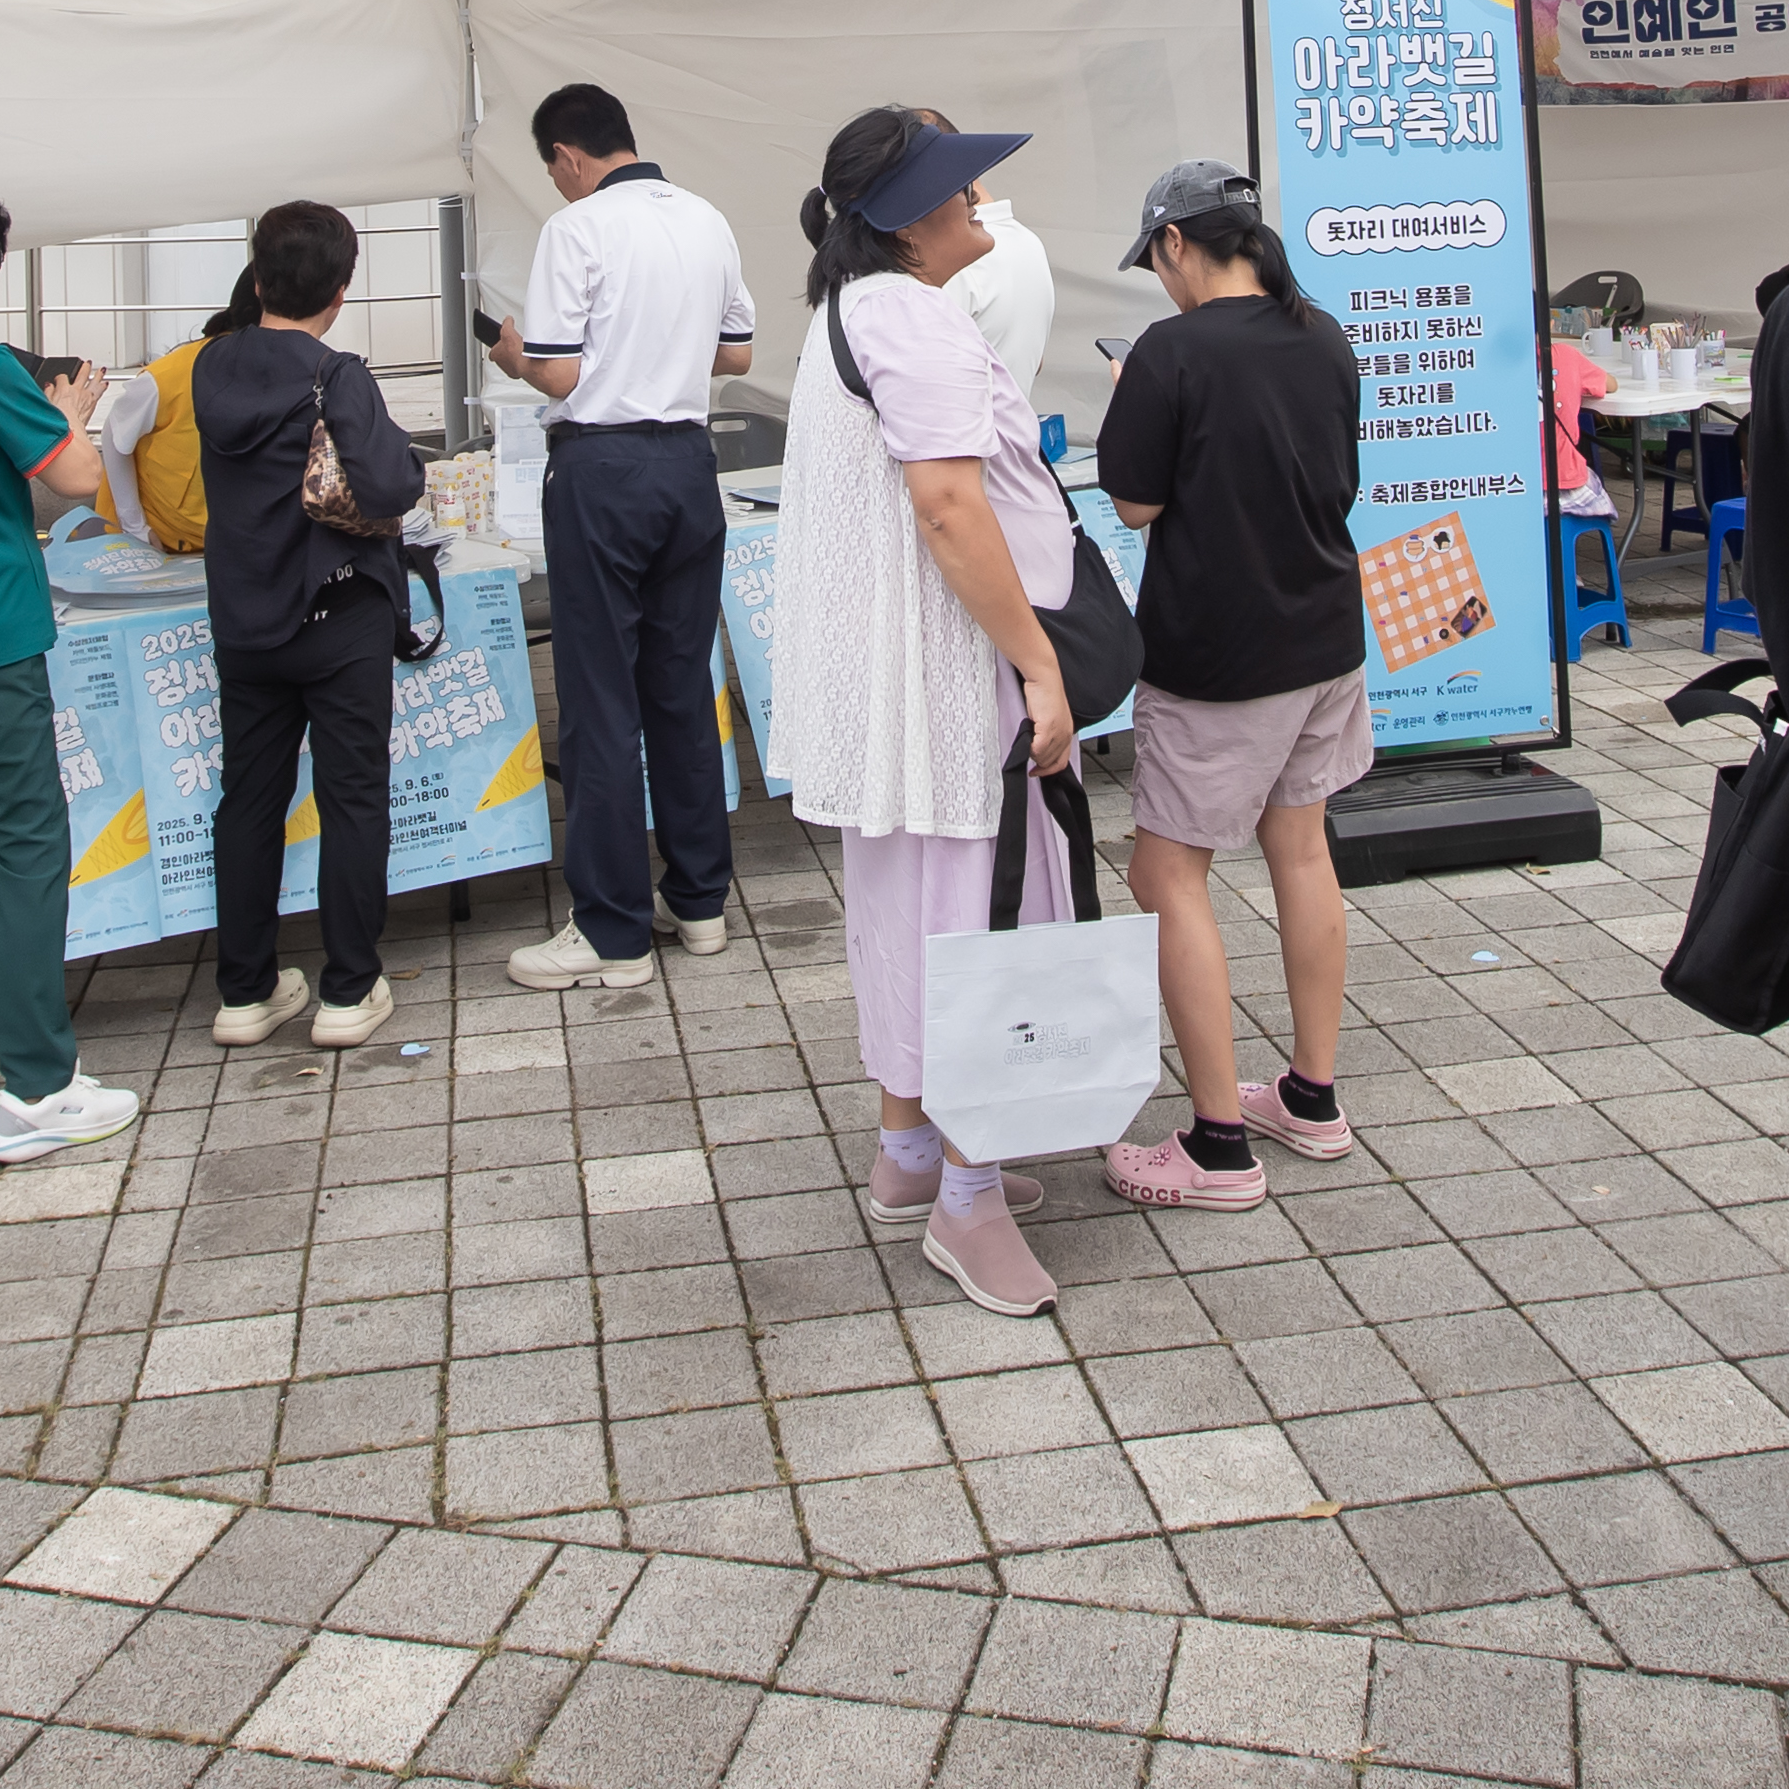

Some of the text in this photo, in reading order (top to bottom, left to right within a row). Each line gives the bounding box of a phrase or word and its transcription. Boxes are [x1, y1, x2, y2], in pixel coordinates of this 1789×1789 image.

[1293, 31, 1498, 91] 아라뱃길
[1710, 44, 1735, 54] 인연
[1295, 91, 1499, 152] 카약축제
[1327, 215, 1487, 242] 돗자리 대여서비스
[1349, 284, 1472, 312] 피크닉 용품을
[1343, 315, 1483, 344] 준비하지 못하신
[1418, 348, 1475, 372] 위하여
[1377, 382, 1454, 407] 돗자리를
[1358, 412, 1498, 441] 비해놓았습니다.
[1370, 475, 1526, 506] 축제종합안내부스
[724, 534, 777, 571] 2025
[336, 564, 353, 581] DO
[141, 619, 213, 661] 2025
[144, 654, 220, 707] 정서
[1437, 684, 1478, 696] K water
[1369, 687, 1427, 701] 인천광역시 서구
[1372, 722, 1387, 732] ter
[405, 779, 418, 791] 9.
[157, 812, 207, 832] 2025. 9.
[389, 820, 467, 845] 라인천여객터미널
[158, 827, 215, 847] 11:00~1
[1119, 1179, 1181, 1203] crocs
